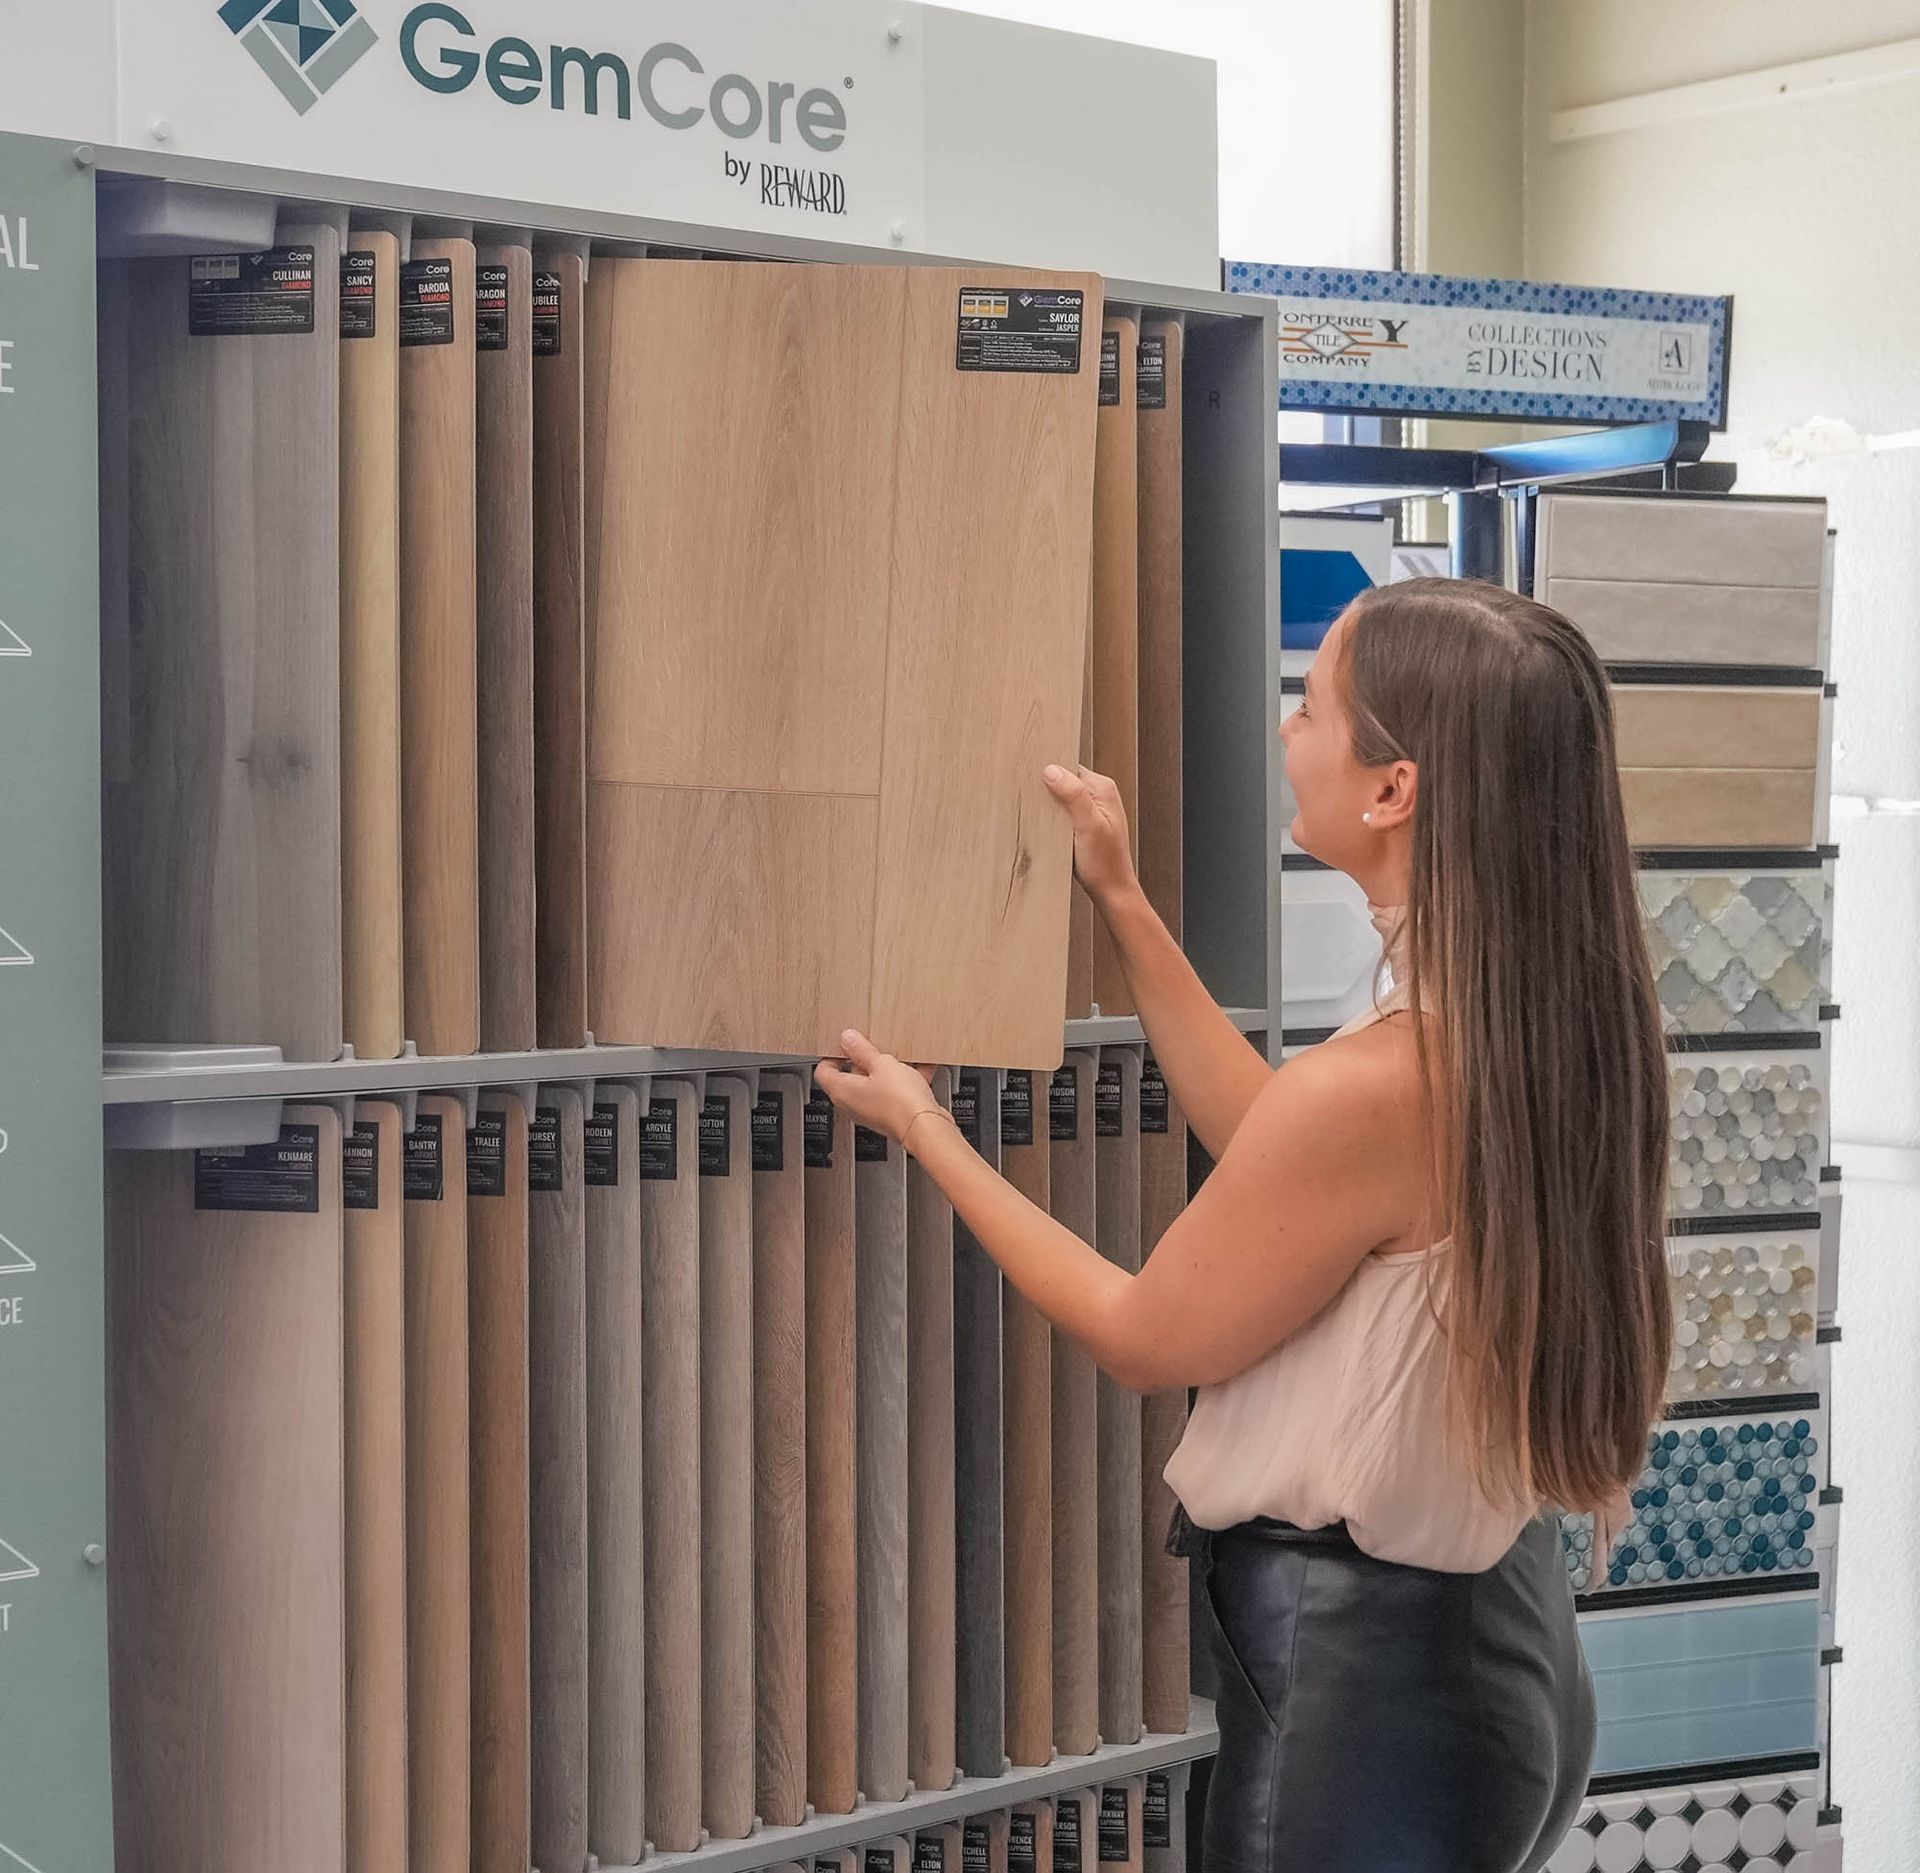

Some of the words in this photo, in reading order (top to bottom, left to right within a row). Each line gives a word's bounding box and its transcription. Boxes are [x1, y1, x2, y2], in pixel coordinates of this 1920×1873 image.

[399, 2, 847, 152] GemCore
[725, 150, 751, 186] by
[760, 163, 845, 214] REWARD
[272, 270, 312, 281] CULLINAN
[346, 275, 373, 286] SANCY
[418, 282, 450, 294] BARODA
[1049, 313, 1080, 323] SAYLOR
[1056, 324, 1080, 332] JASPER
[1313, 333, 1342, 347] TILE
[1467, 322, 1607, 349] COLLECTIONS
[1143, 357, 1163, 366] ELTON
[1283, 354, 1371, 367] COMPANY
[1487, 347, 1604, 382] DESIGN
[645, 1123, 672, 1133] ARGYLE
[408, 1140, 438, 1150] BANTRY
[474, 1137, 500, 1147] TRALEE
[278, 1151, 313, 1162] KENMARE
[921, 1860, 941, 1869] ELTON
